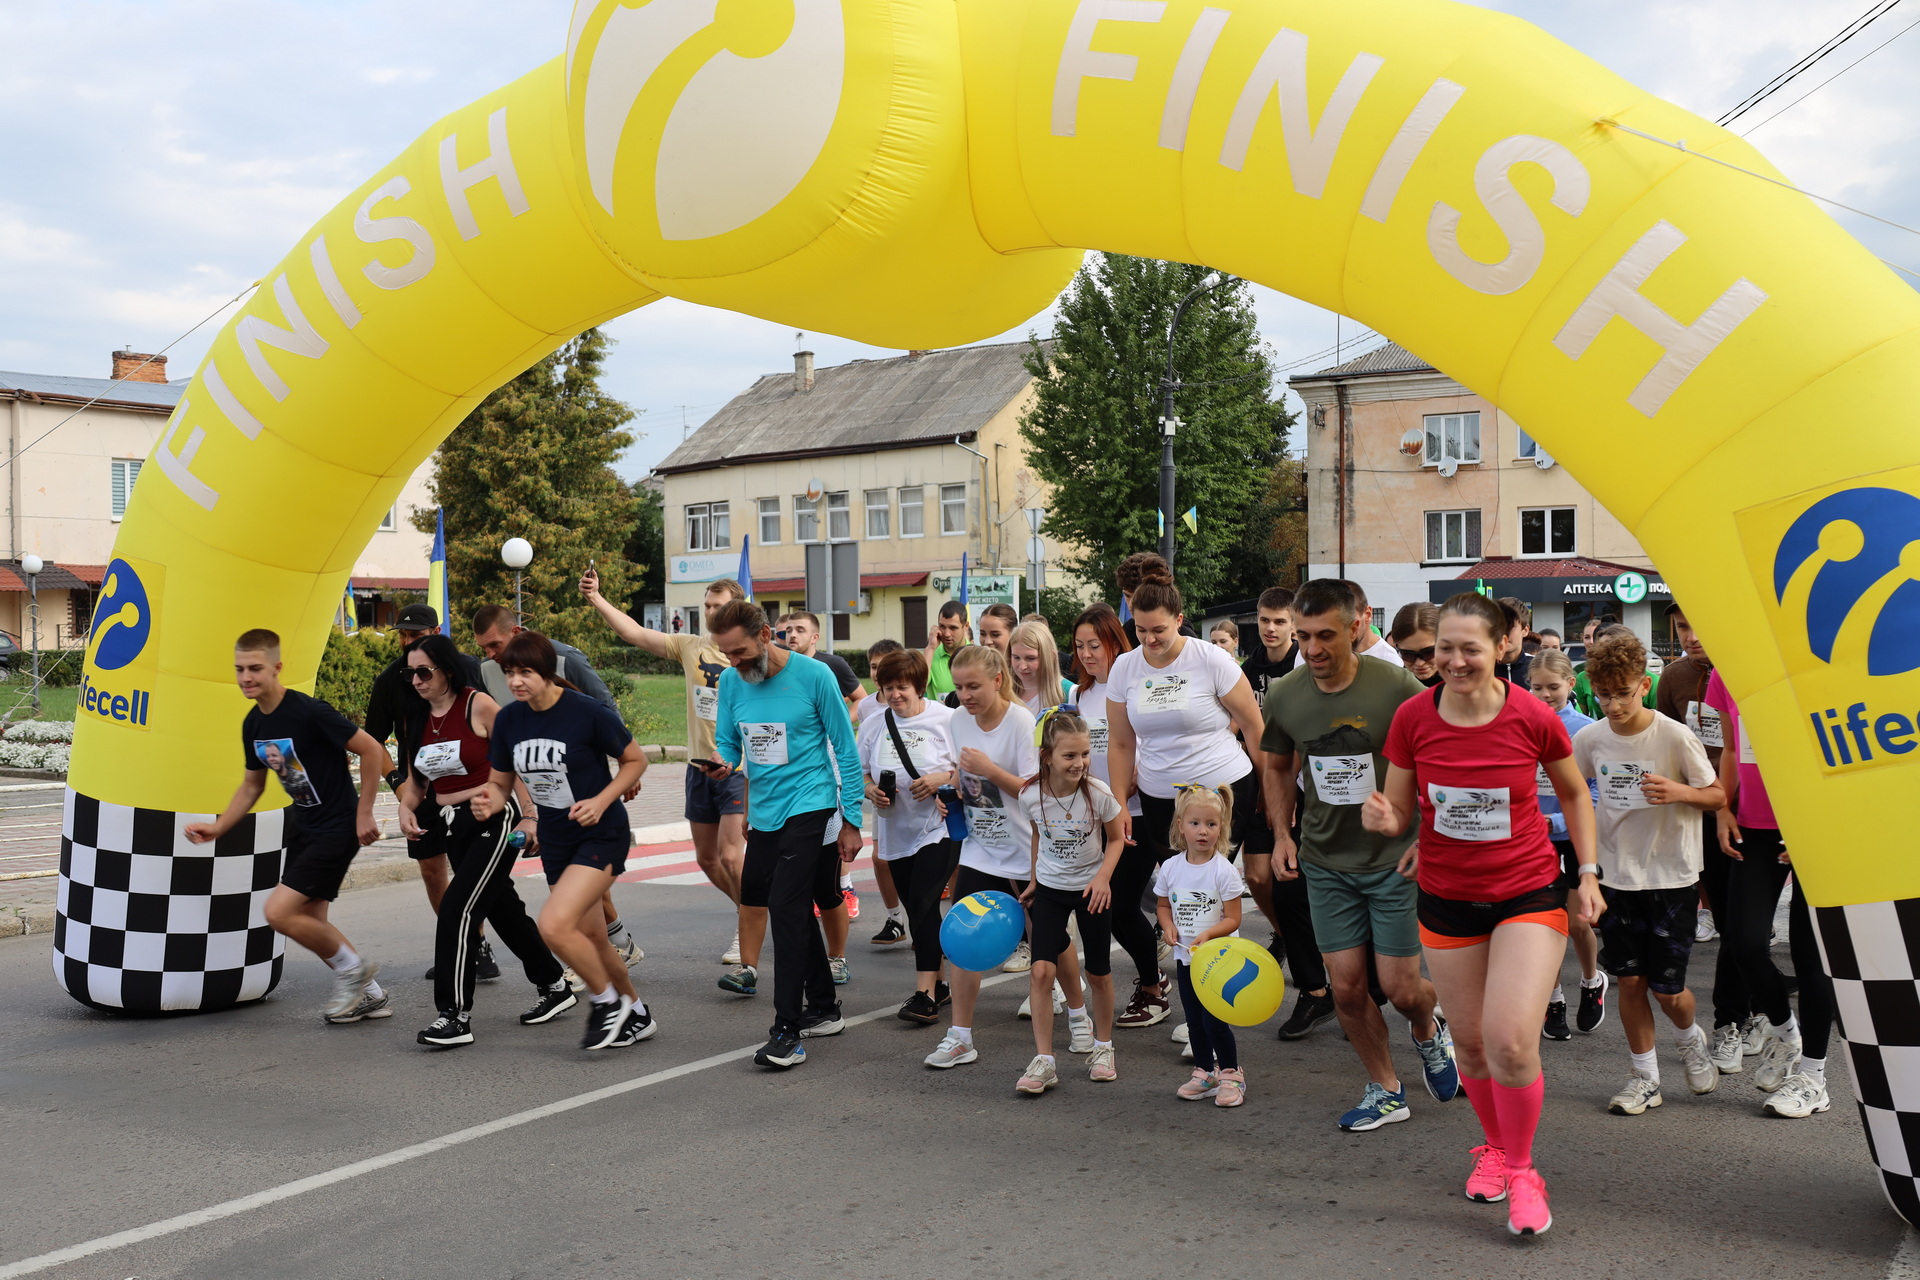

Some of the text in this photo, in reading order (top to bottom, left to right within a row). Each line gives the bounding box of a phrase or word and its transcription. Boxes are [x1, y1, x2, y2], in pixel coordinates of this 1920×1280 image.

[1050, 0, 1769, 419] FINISH
[155, 106, 531, 512] FINISH
[1563, 583, 1613, 594] АПТЕКА
[78, 672, 149, 726] ifecell
[513, 738, 568, 774] NIKE
[1810, 702, 1920, 767] life
[1200, 955, 1221, 986] Україну
